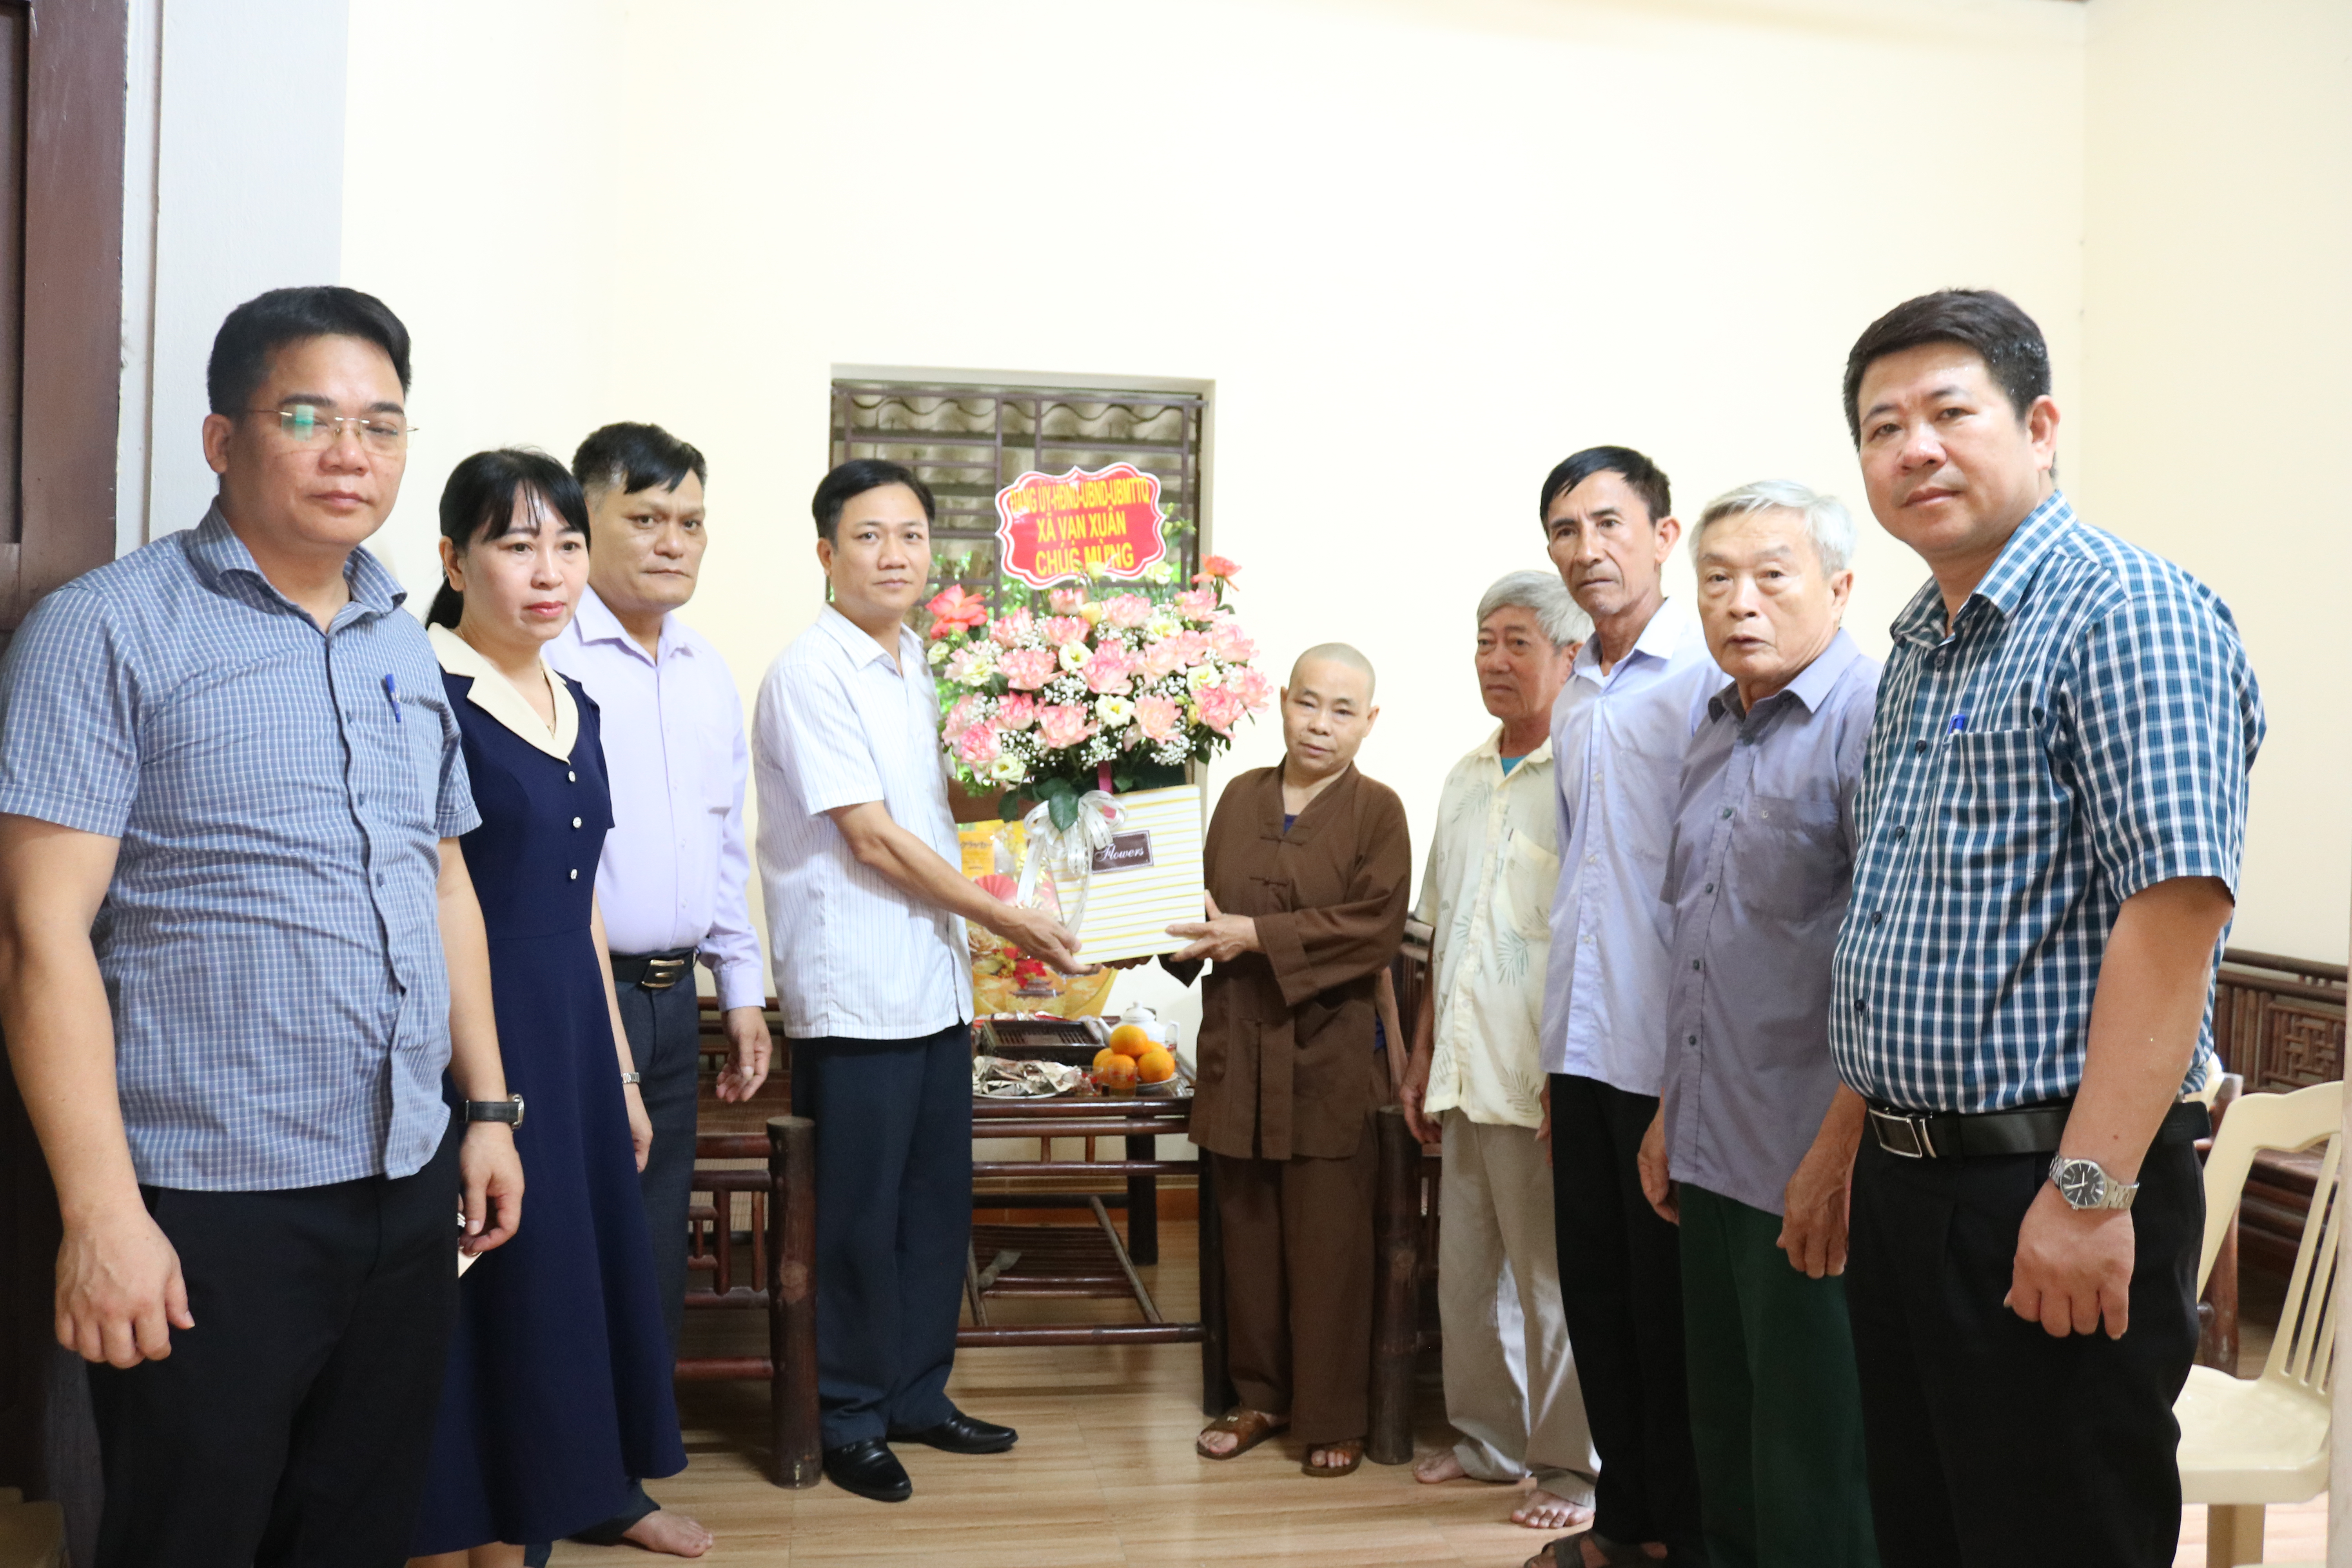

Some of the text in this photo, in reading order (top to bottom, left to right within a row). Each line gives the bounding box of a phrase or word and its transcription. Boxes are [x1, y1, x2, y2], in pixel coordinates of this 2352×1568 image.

[1036, 505, 1127, 547] XÃ VẠN XUÂN
[1035, 538, 1134, 576] CHÚC MỪNG
[1095, 844, 1144, 862] Flowers
